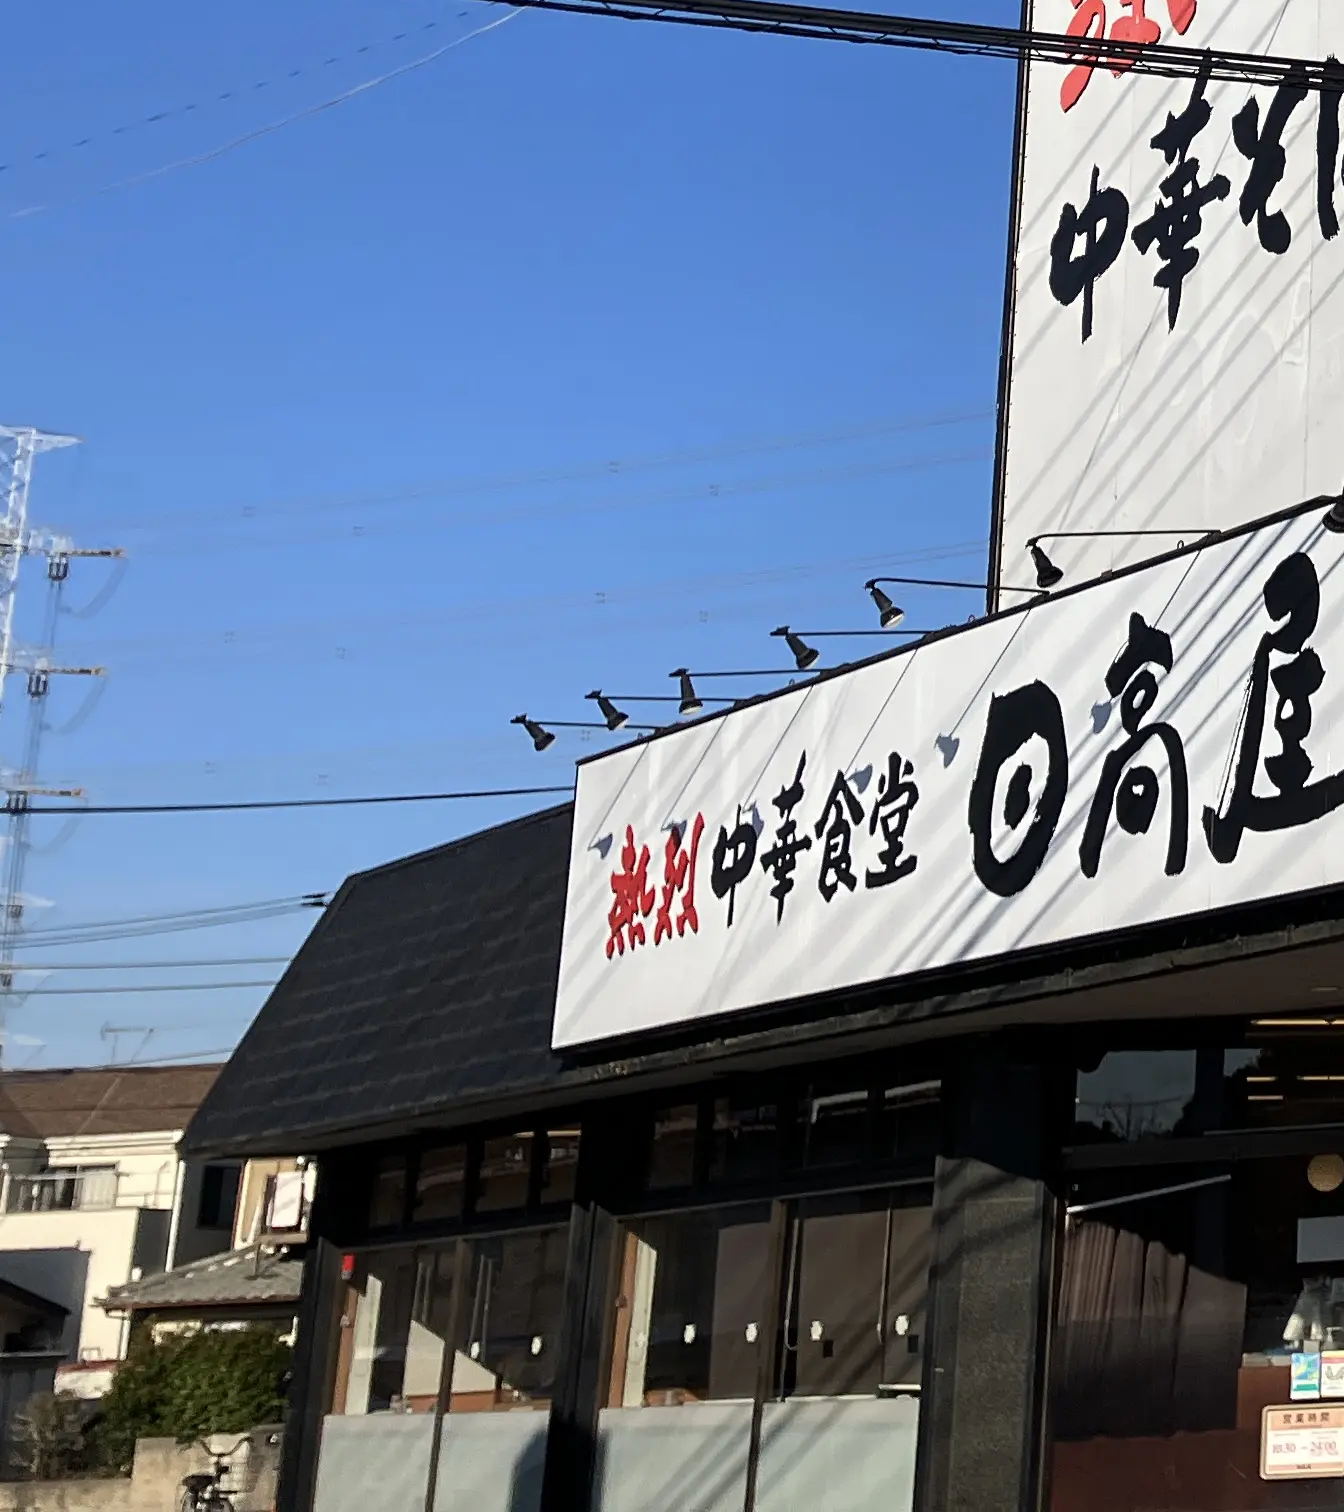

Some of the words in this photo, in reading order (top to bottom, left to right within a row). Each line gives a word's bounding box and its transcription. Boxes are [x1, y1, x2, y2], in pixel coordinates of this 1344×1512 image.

[605, 811, 705, 958] 熱烈
[711, 750, 920, 926] 中華食堂
